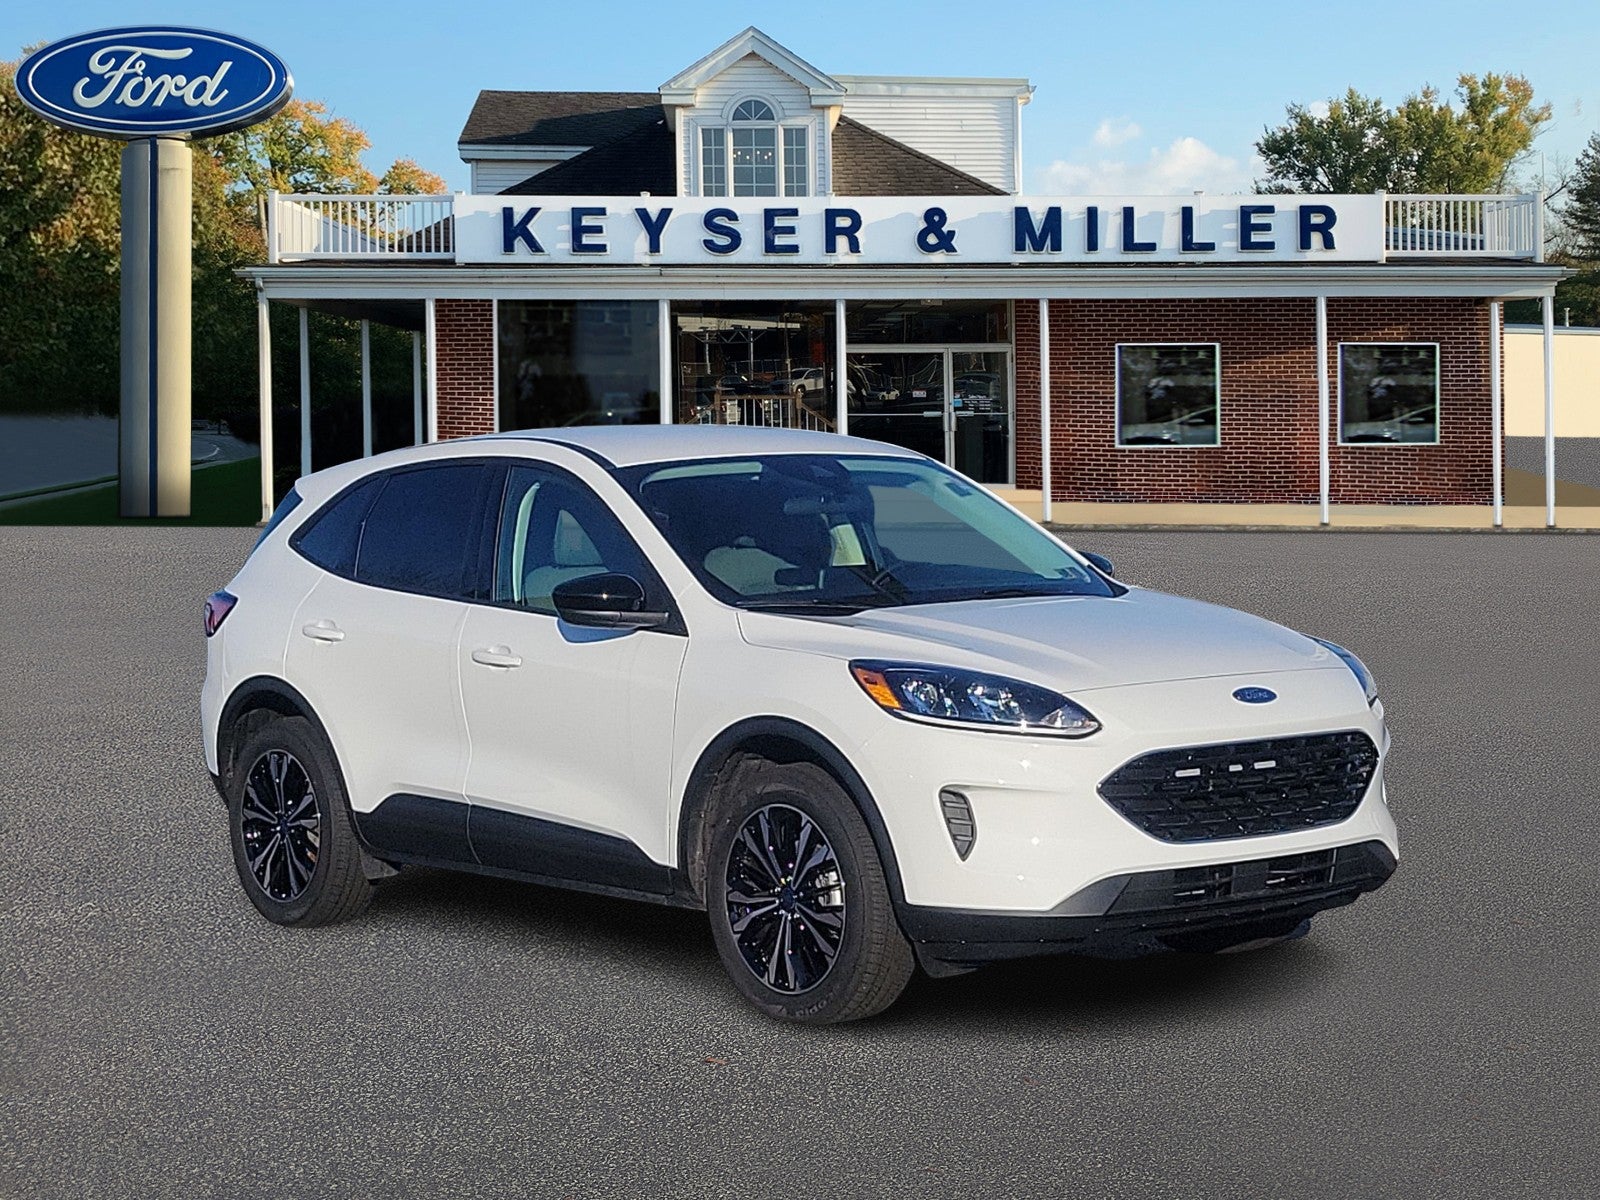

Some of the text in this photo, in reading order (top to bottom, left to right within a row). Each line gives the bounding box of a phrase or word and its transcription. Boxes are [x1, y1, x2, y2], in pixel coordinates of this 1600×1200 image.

[72, 45, 233, 108] Ford
[502, 205, 1337, 253] KEYSER & MILLER
